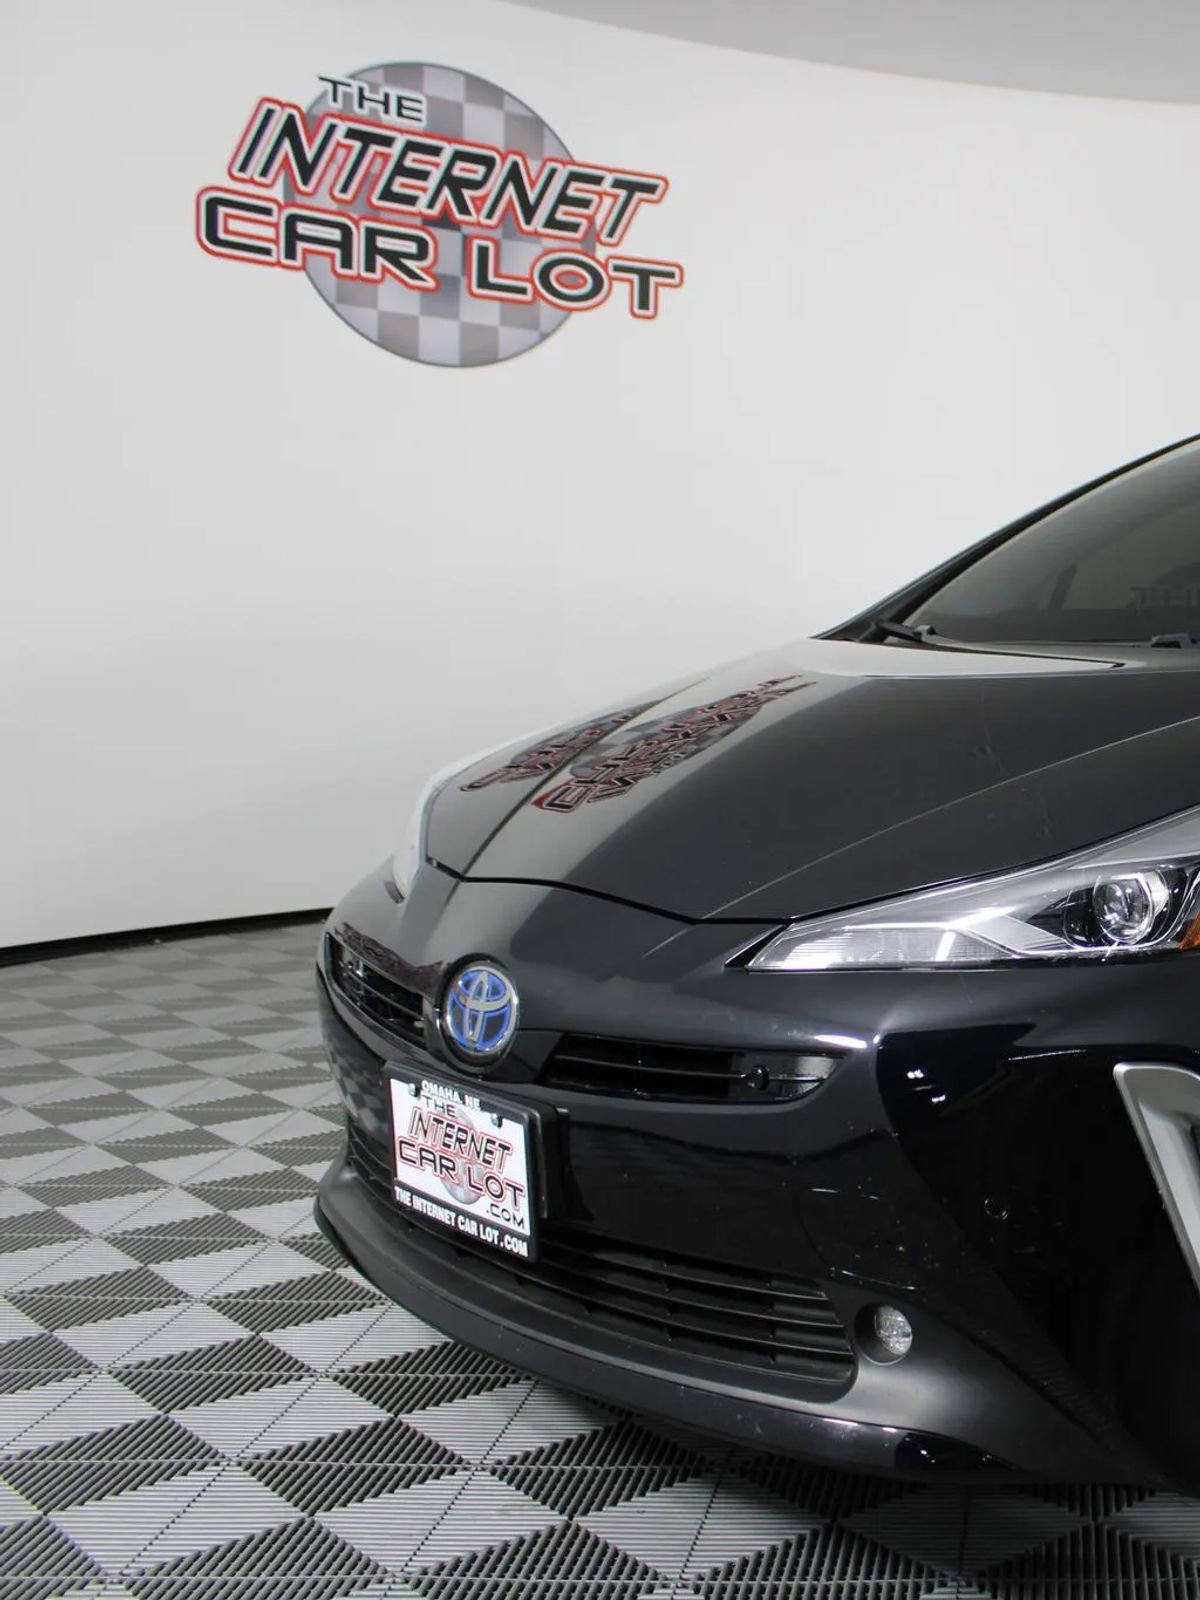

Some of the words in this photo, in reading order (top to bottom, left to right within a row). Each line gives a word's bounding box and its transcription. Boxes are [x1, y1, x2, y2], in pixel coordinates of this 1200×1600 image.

[317, 74, 424, 123] THE
[232, 101, 665, 243] INTERNET
[200, 190, 437, 288] CAR
[470, 236, 680, 316] LOT
[421, 1093, 457, 1118] THE
[409, 1107, 511, 1172] INTERNET
[398, 1138, 458, 1182] CAR
[468, 1163, 525, 1210] LOT
[394, 1186, 412, 1207] THE
[412, 1194, 456, 1228] INTERNET
[457, 1214, 479, 1237] CAR
[479, 1223, 499, 1246] LOT
[486, 1203, 526, 1230] .COM
